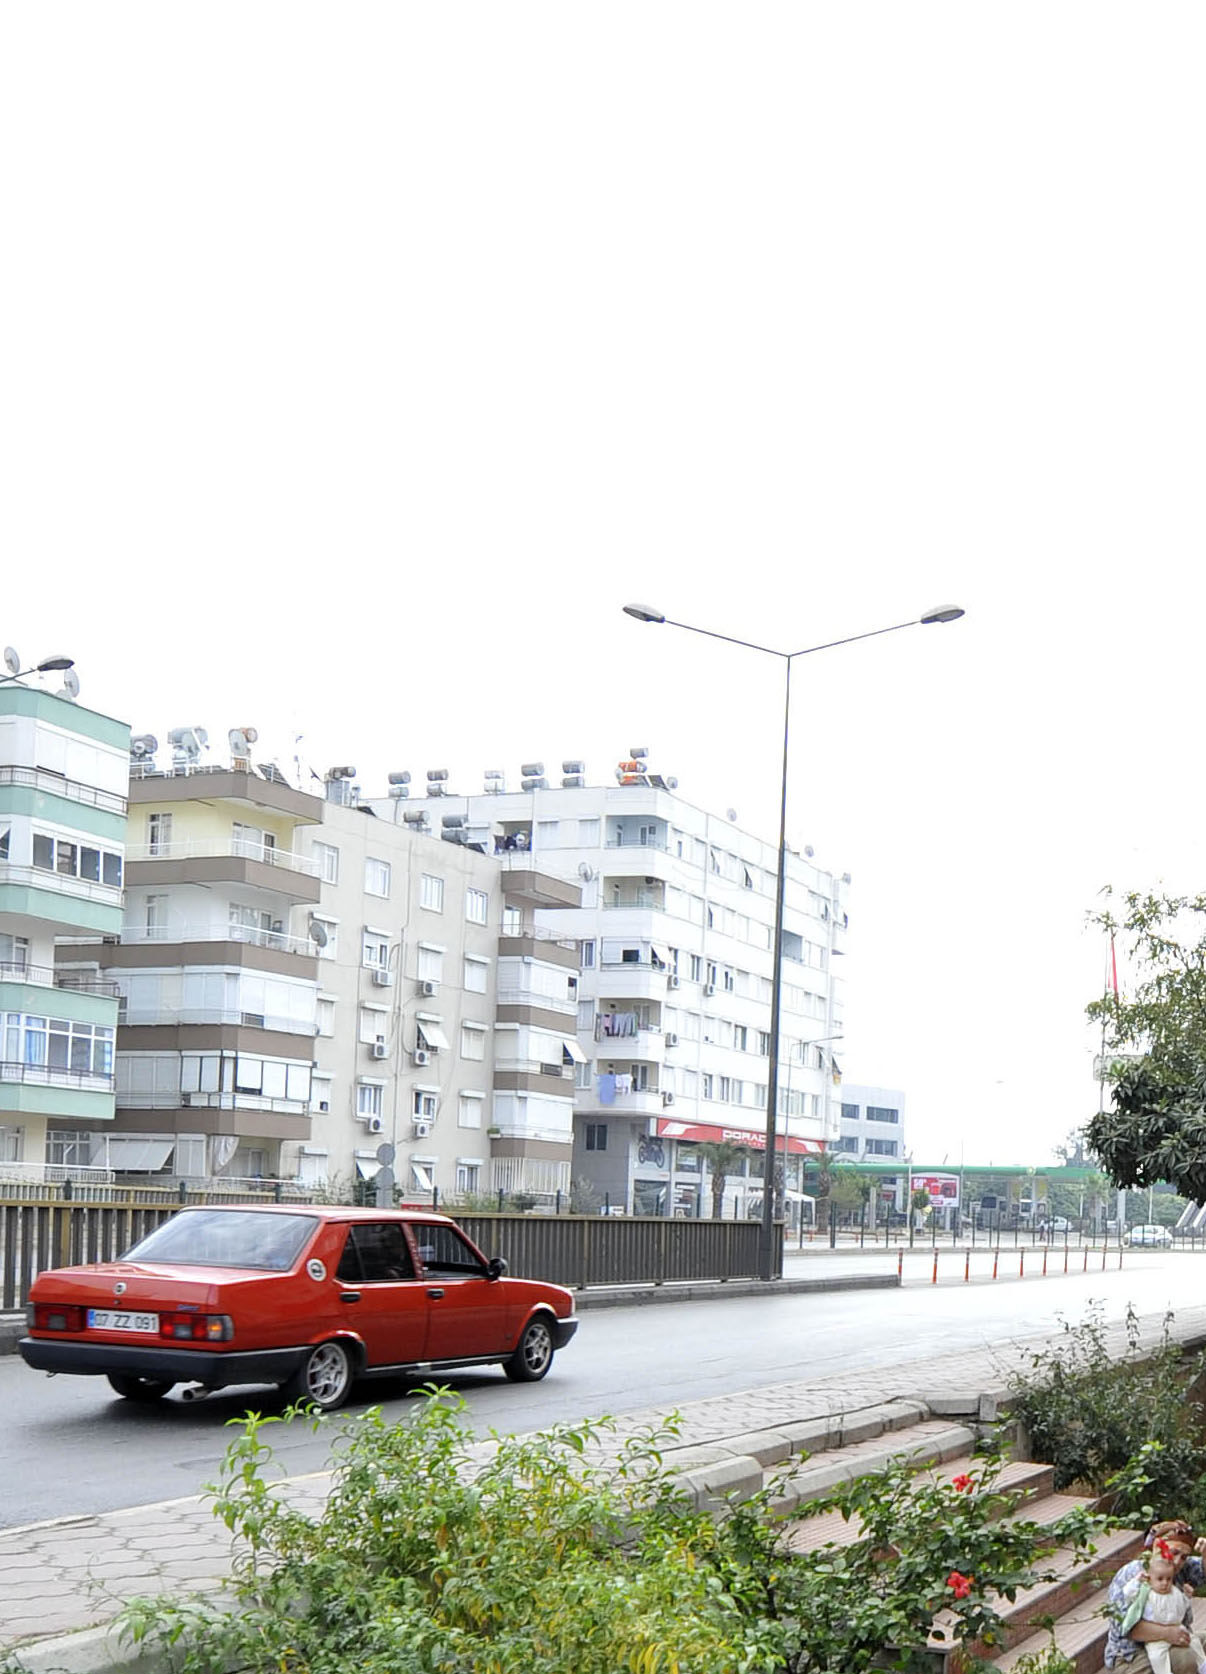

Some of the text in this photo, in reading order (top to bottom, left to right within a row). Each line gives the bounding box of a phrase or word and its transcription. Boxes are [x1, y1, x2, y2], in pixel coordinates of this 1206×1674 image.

[94, 1313, 157, 1329] 07 ZZ 091
